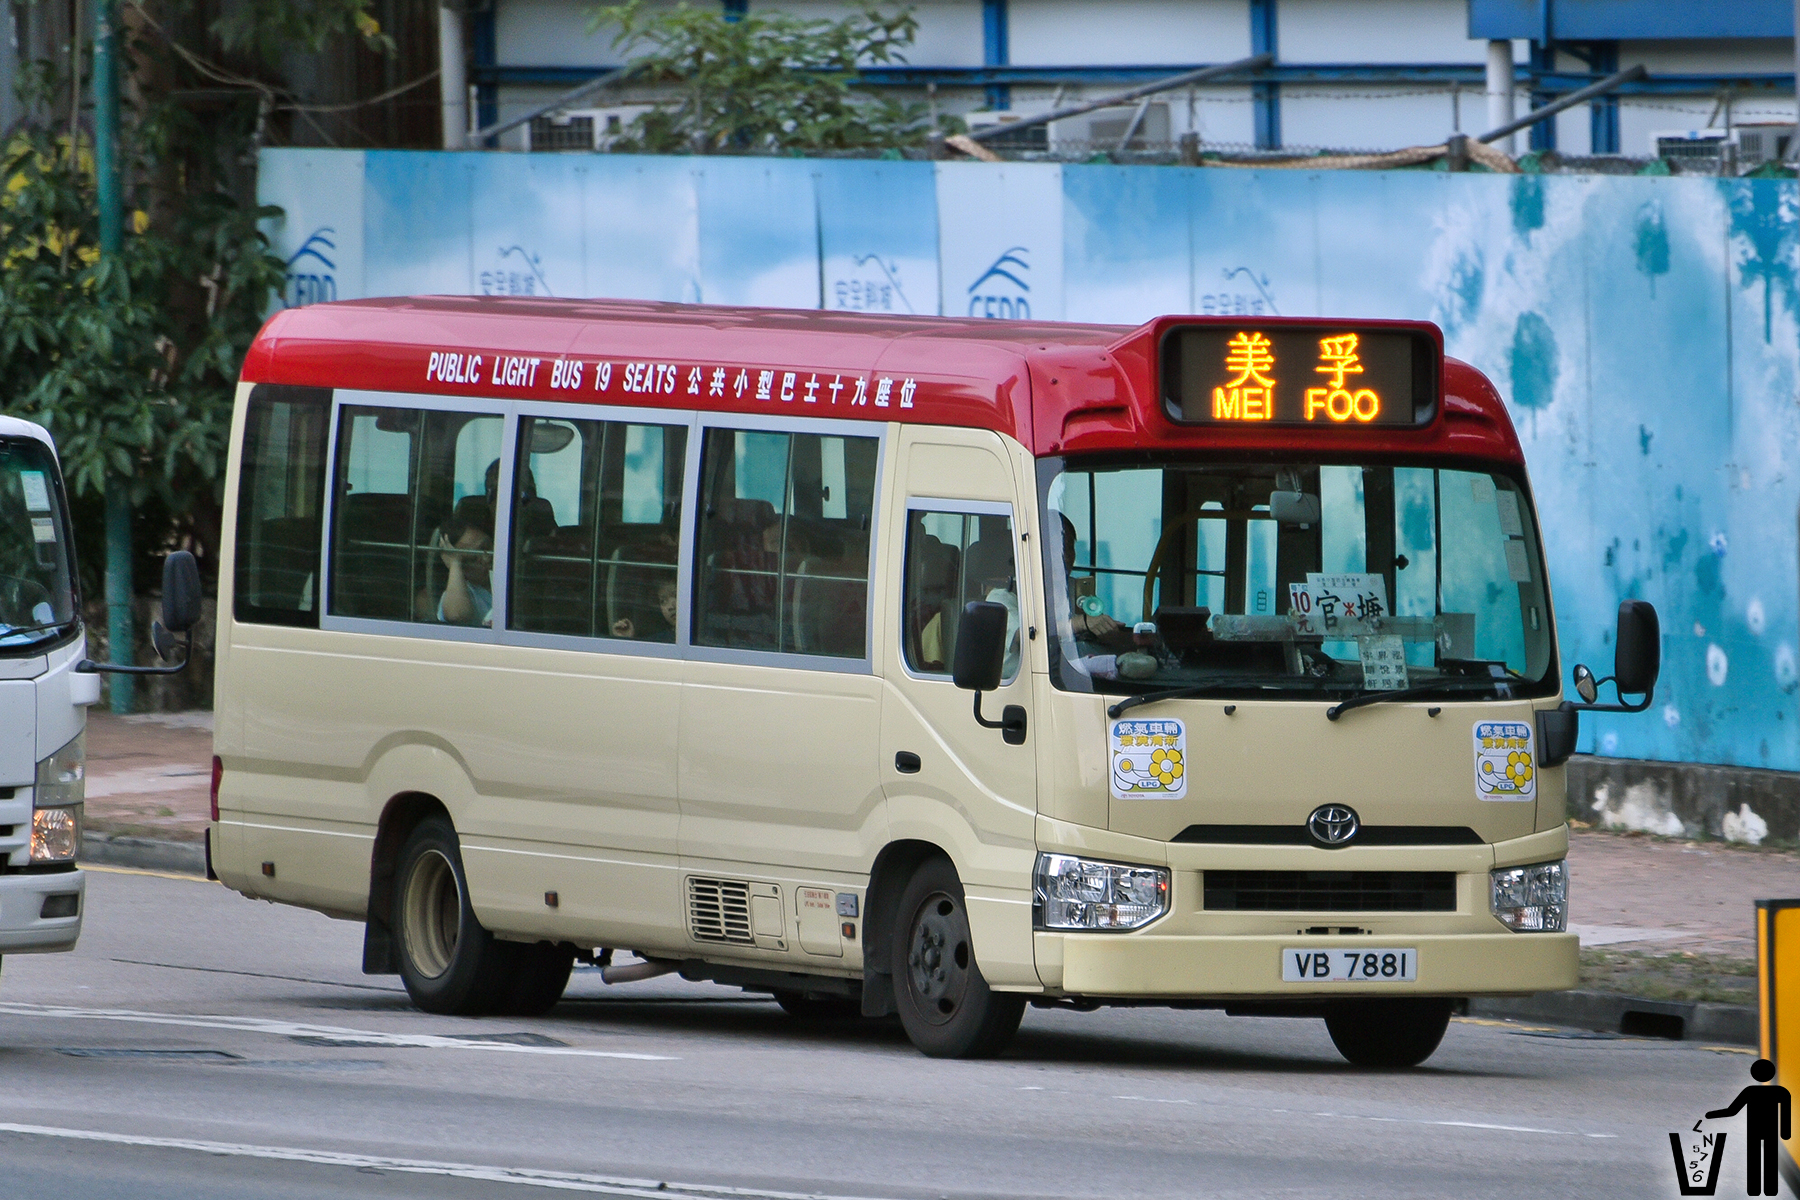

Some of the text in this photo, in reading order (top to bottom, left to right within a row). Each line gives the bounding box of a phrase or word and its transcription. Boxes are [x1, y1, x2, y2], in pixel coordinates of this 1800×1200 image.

[426, 351, 918, 409] PUBLIC LIGHT BUS 19 SEATS 公共小型巴士十九座位
[1212, 386, 1381, 422] MEI FOO
[1292, 591, 1311, 613] 10
[1295, 953, 1406, 978] VB 7881
